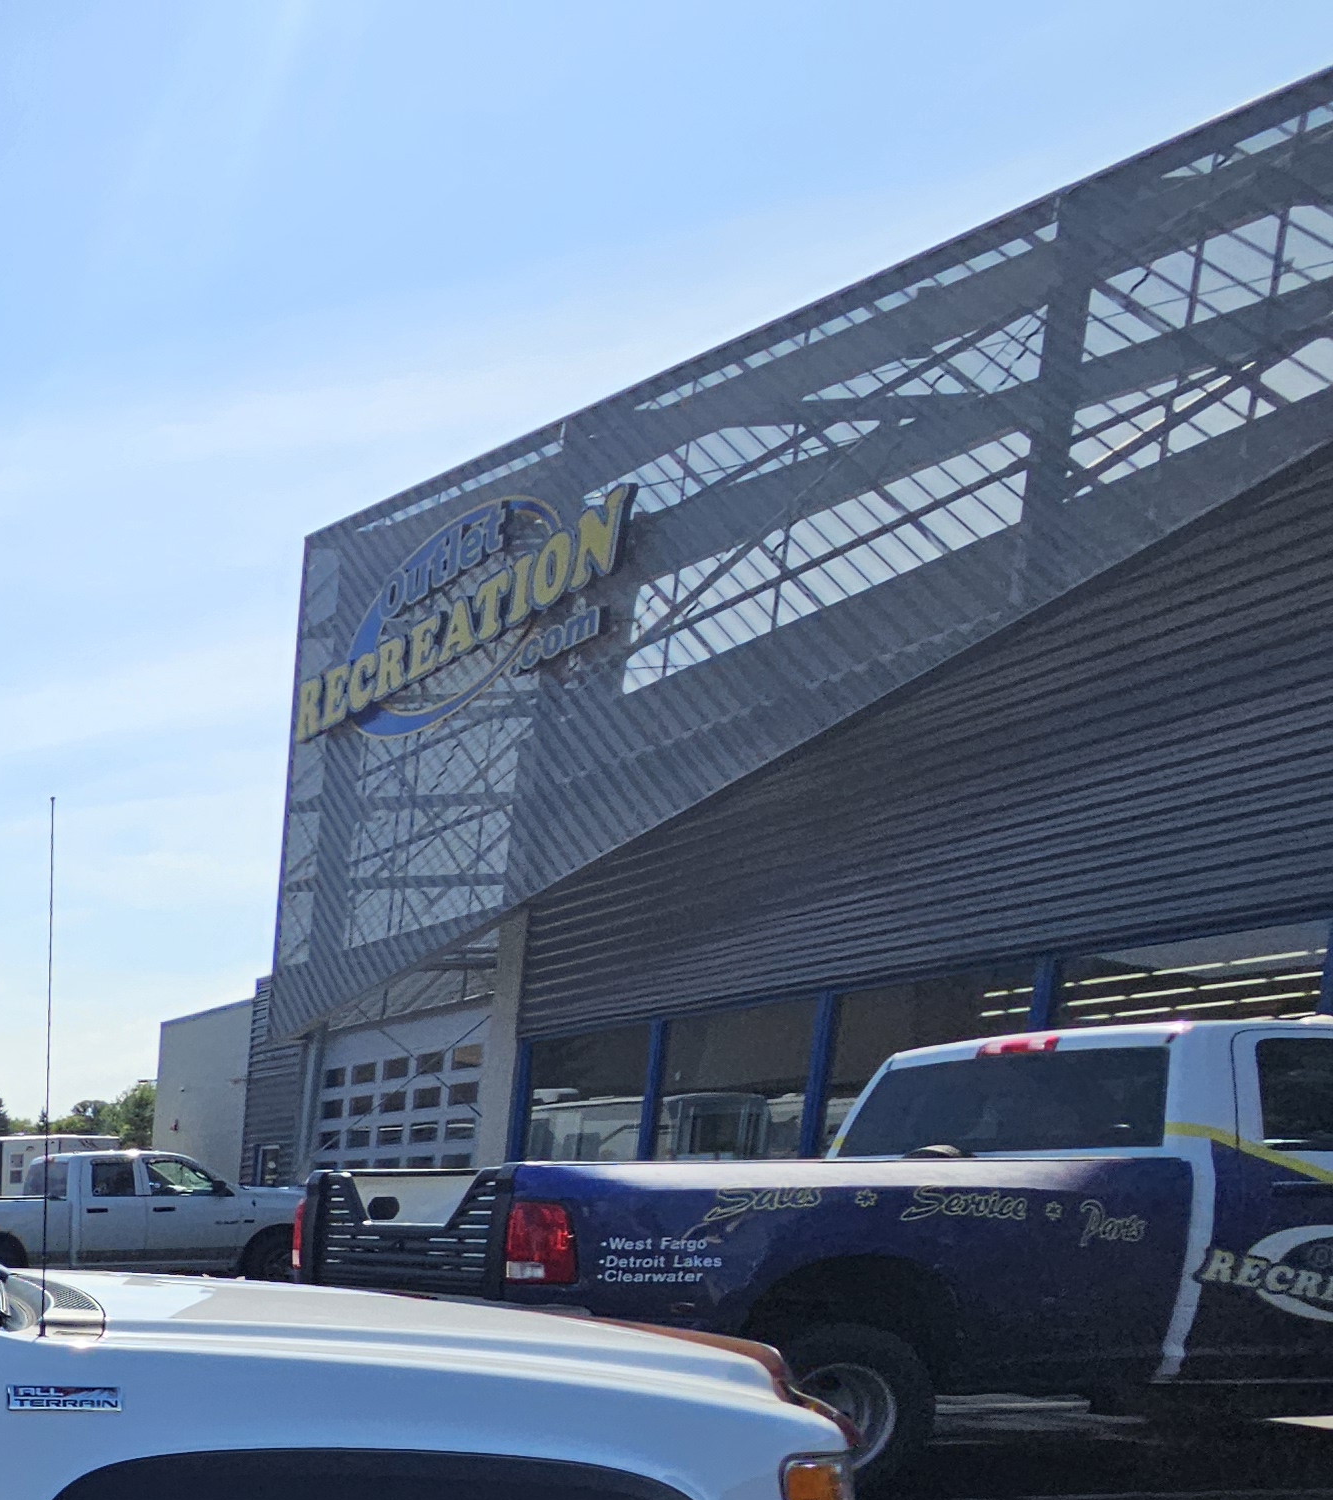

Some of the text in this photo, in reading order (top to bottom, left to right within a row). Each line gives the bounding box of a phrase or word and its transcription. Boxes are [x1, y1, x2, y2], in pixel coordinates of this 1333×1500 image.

[380, 501, 505, 619] Outlet
[295, 484, 634, 744] RECREATION
[702, 1183, 1148, 1247] Sales Service Parts
[608, 1237, 653, 1250] West
[604, 1254, 722, 1268] Detroit Lakes
[603, 1270, 703, 1282] Clearwater
[18, 1387, 64, 1396] ALL
[14, 1398, 118, 1408] TERRAIN
